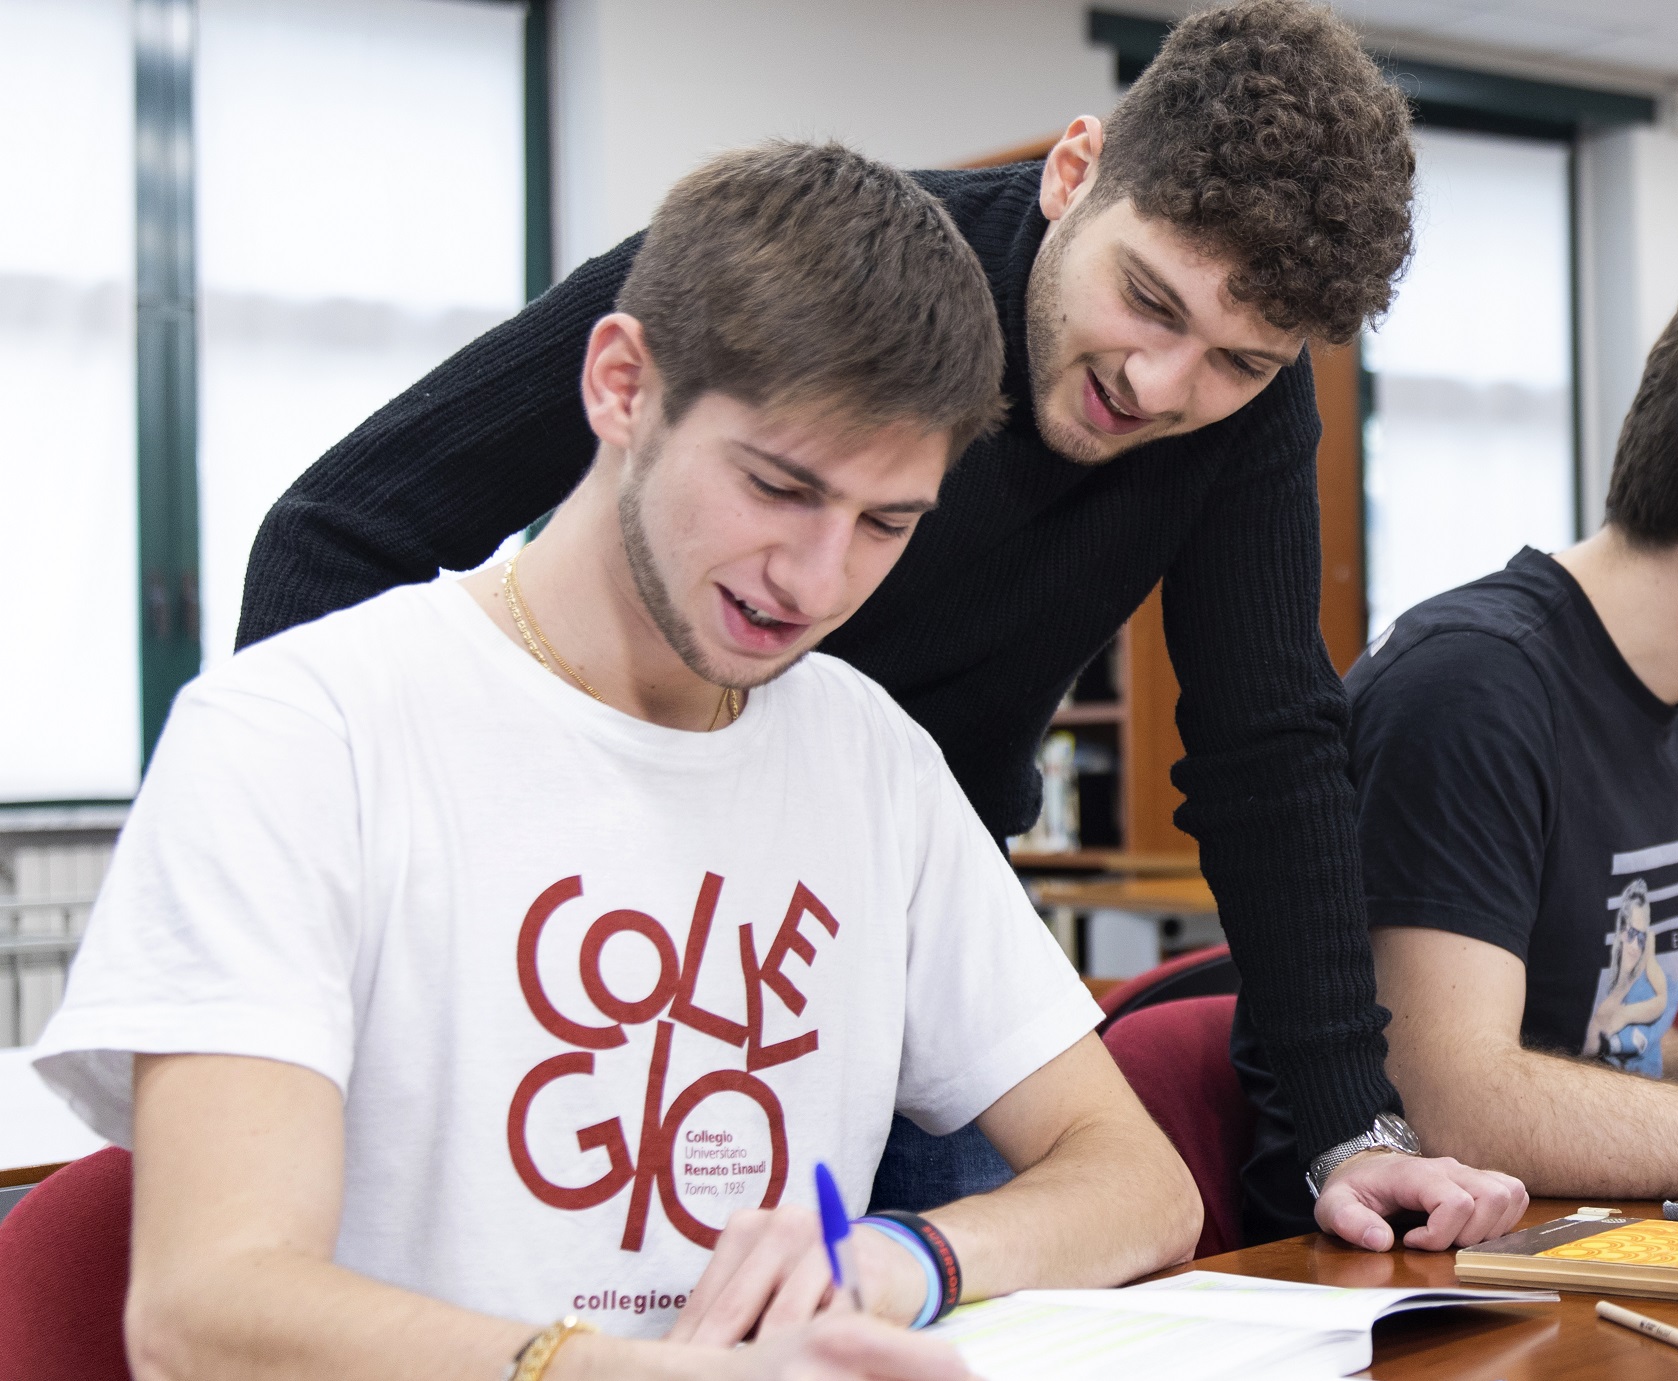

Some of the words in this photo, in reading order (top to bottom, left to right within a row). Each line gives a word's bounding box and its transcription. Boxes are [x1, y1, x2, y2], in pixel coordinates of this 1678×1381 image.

[686, 1130, 733, 1146] Collegio
[685, 1146, 748, 1160] Universitario
[684, 1163, 729, 1176] Renato
[732, 1161, 766, 1176] Einaudi
[684, 1182, 719, 1197] Torino,
[724, 1181, 746, 1195] 1935
[573, 1289, 694, 1315] collegioe
